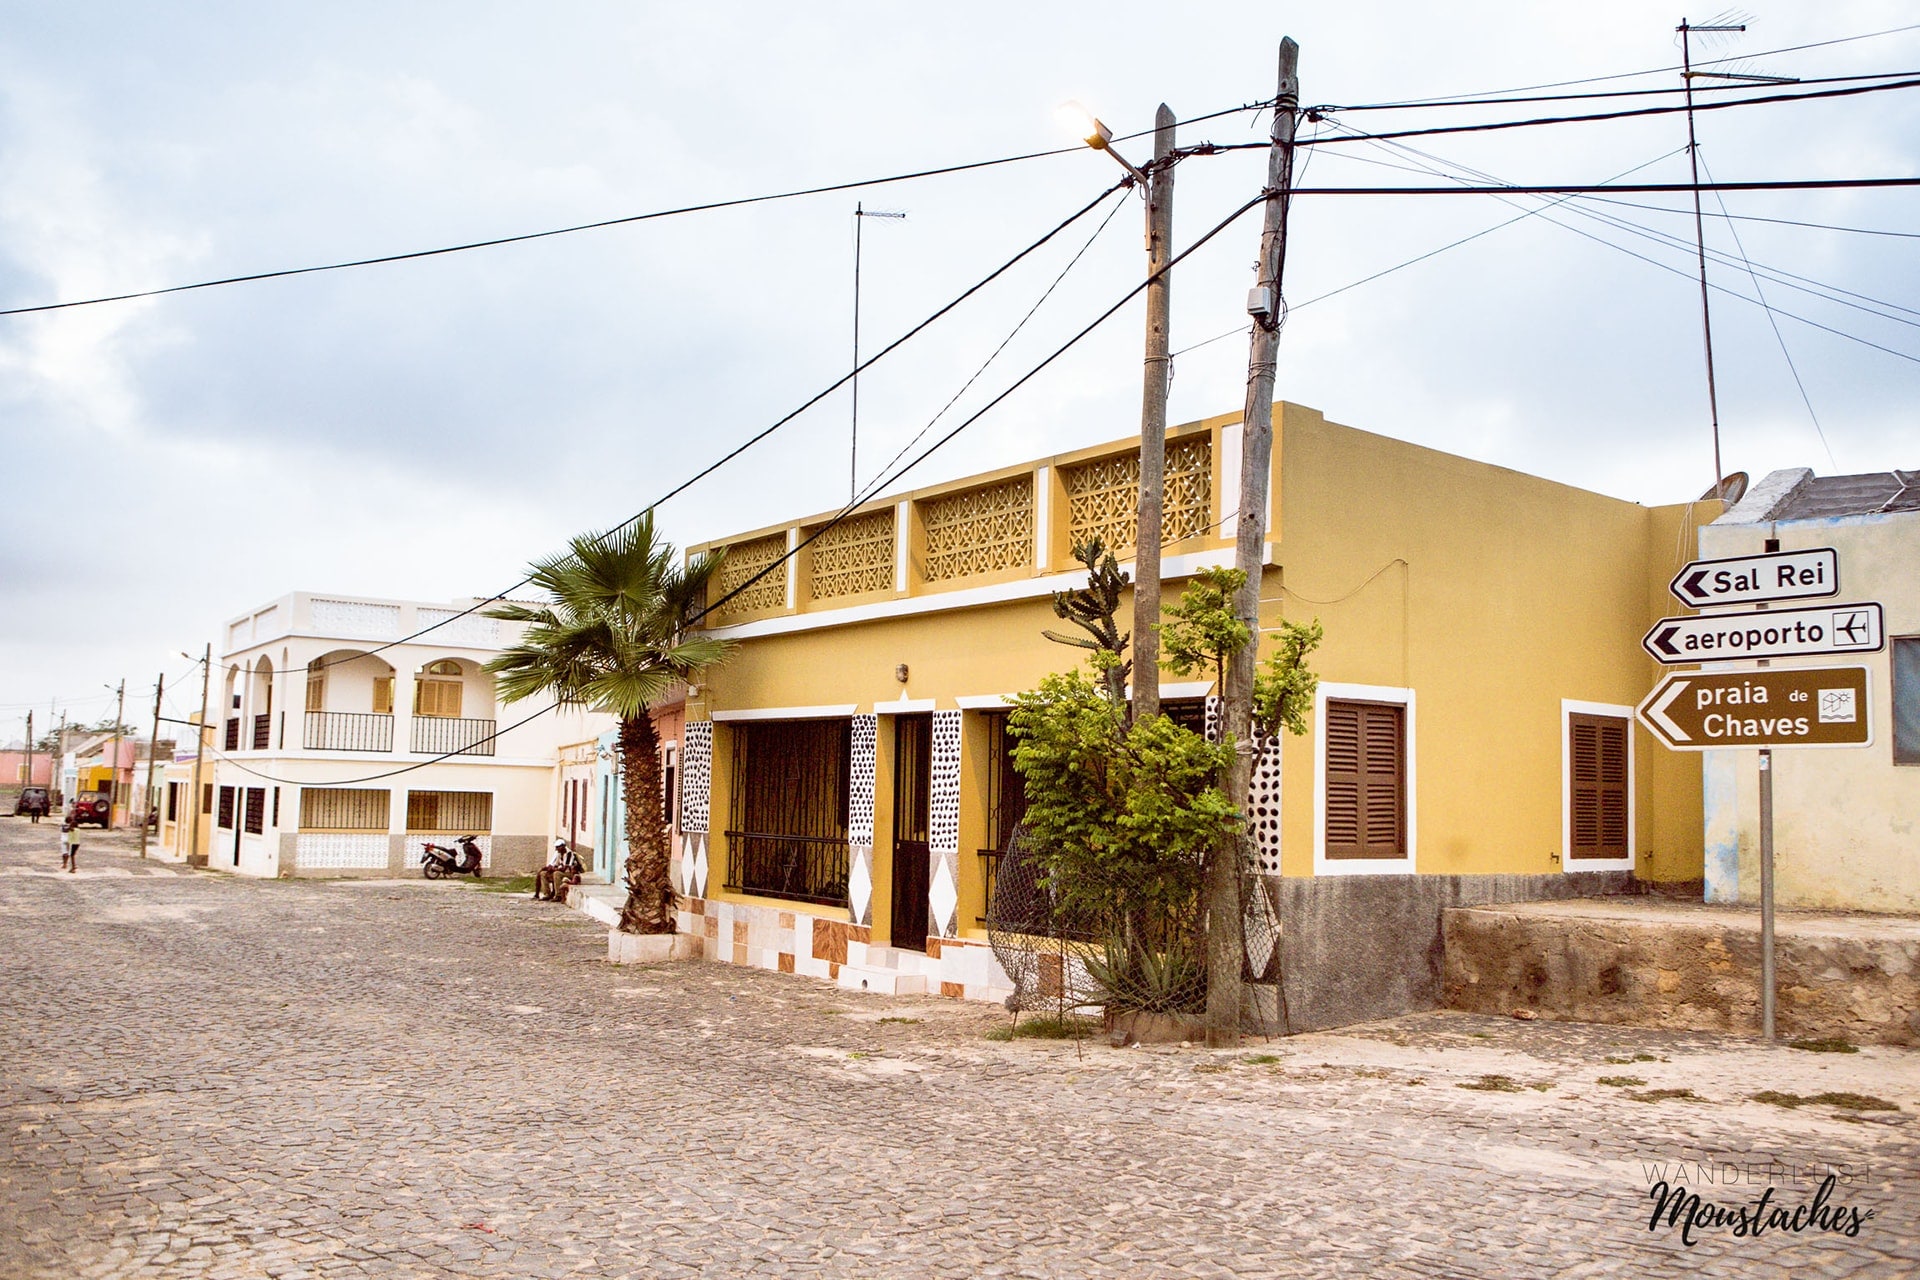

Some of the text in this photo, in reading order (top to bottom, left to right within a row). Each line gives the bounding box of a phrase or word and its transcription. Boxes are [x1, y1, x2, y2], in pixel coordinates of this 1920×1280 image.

[1713, 561, 1823, 593] Sal Rei
[1684, 620, 1823, 651] aeroporto
[1697, 681, 1809, 710] praia de
[1703, 714, 1809, 738] Chaves
